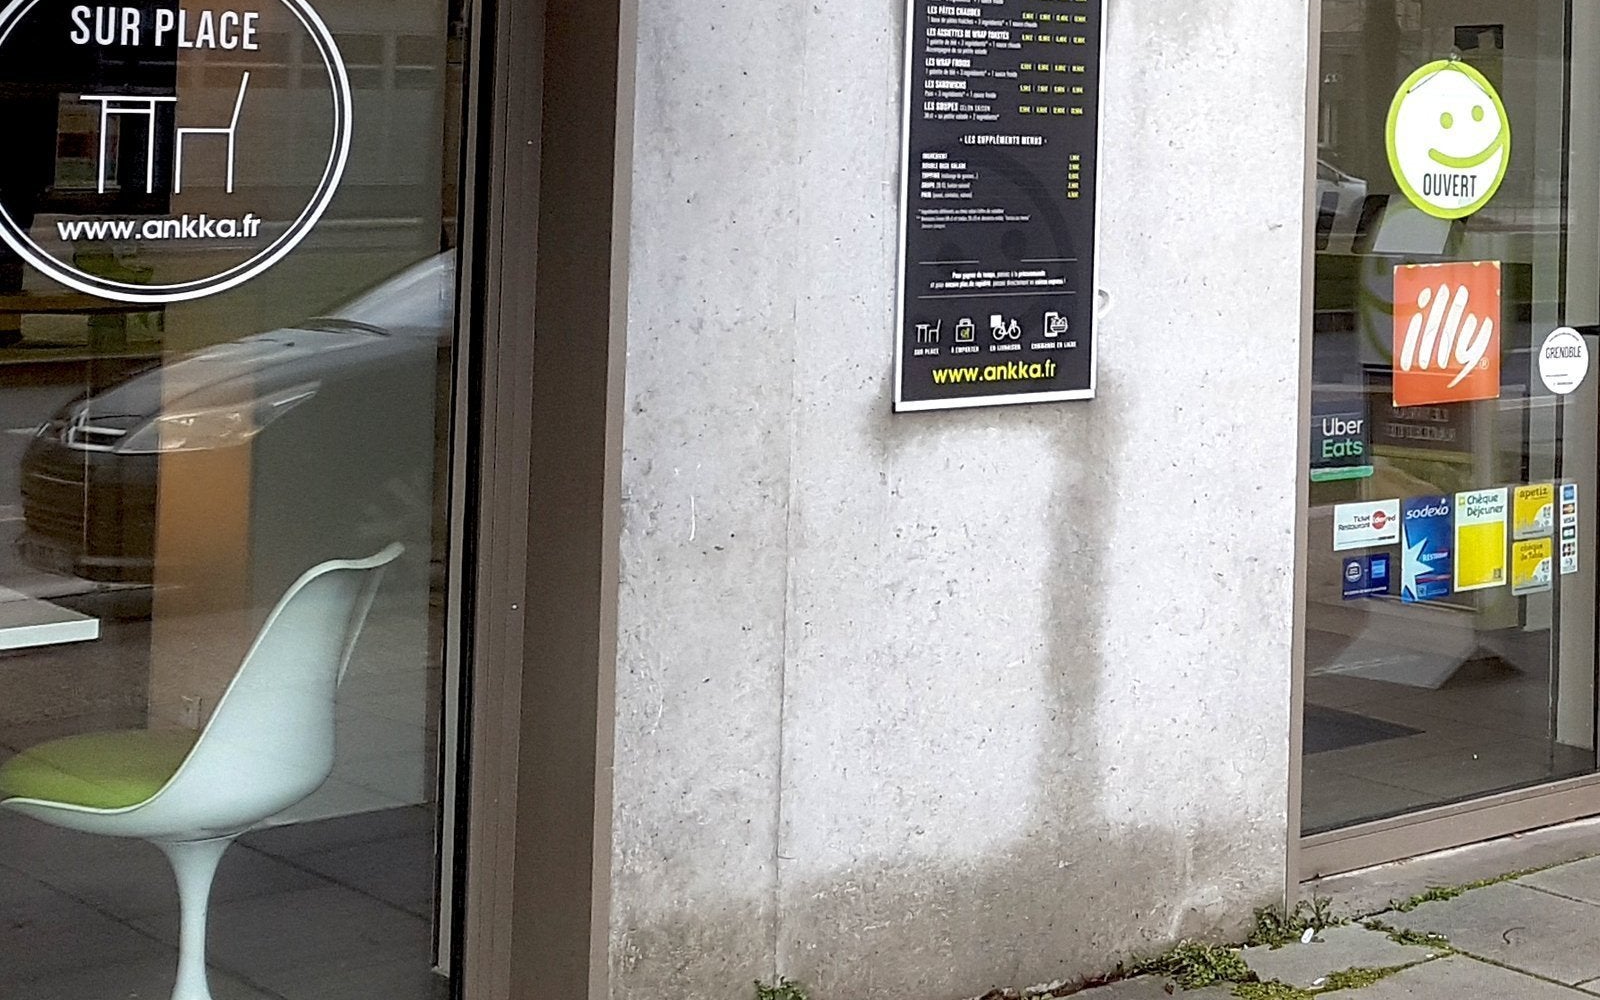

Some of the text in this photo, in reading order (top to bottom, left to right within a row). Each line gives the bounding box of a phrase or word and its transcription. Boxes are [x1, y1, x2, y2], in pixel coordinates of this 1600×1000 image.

[70, 5, 260, 50] SUR PLACE
[1423, 172, 1477, 198] OUVERT
[57, 213, 261, 241] www.ankka.fr
[1400, 284, 1493, 388] illy
[1545, 345, 1581, 359] GRENOBLE
[932, 359, 1056, 384] www.ankka.fr
[1322, 417, 1363, 437] Uber
[1322, 439, 1363, 458] Eats
[1466, 492, 1499, 506] Chèque
[1519, 487, 1549, 500] apetiz
[1405, 504, 1449, 520] sodexo
[1466, 504, 1504, 518] Déjeuner
